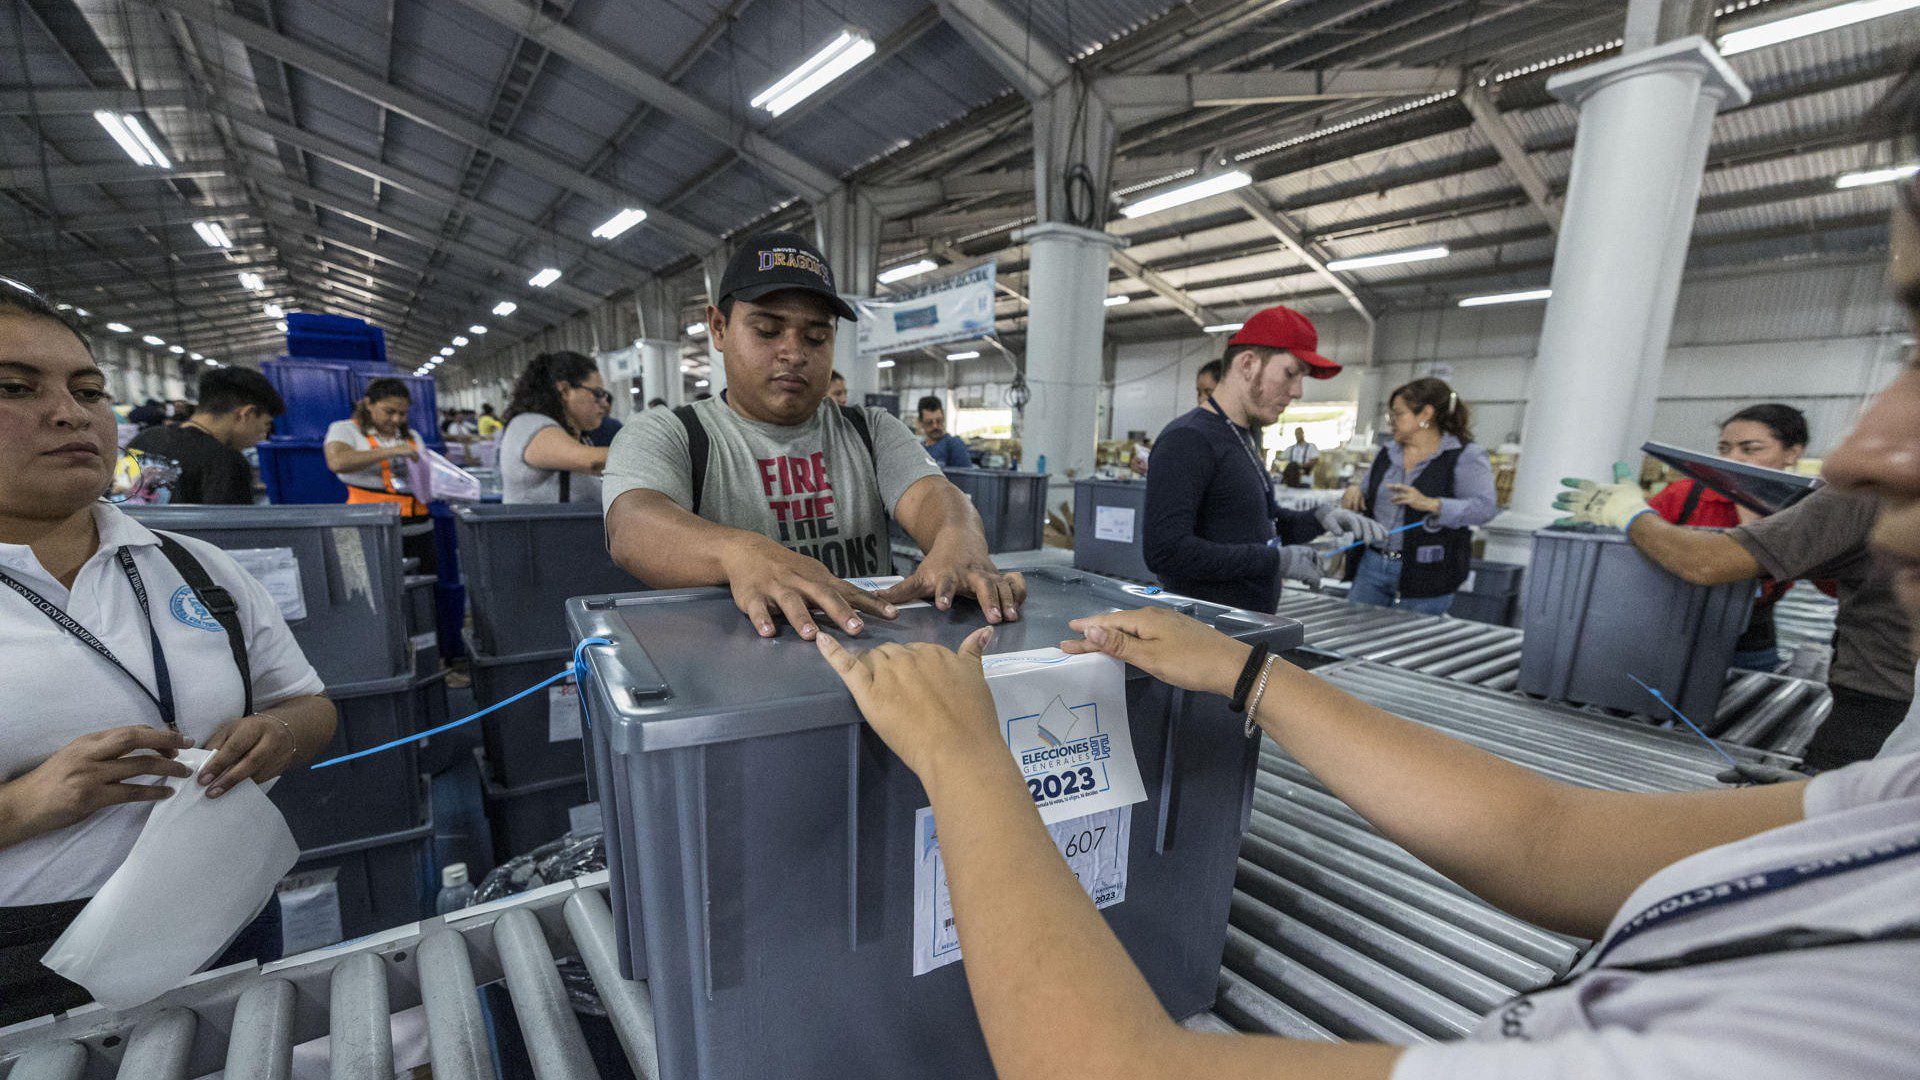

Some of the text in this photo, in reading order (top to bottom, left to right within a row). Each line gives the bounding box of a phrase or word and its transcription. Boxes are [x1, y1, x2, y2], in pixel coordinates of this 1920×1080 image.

[757, 451, 833, 496] FIRE
[1021, 741, 1090, 766] ELECCIONES
[1023, 752, 1091, 774] GENERALES
[1027, 766, 1096, 803] 2023
[1065, 826, 1107, 858] 607
[1095, 891, 1117, 904] 2023
